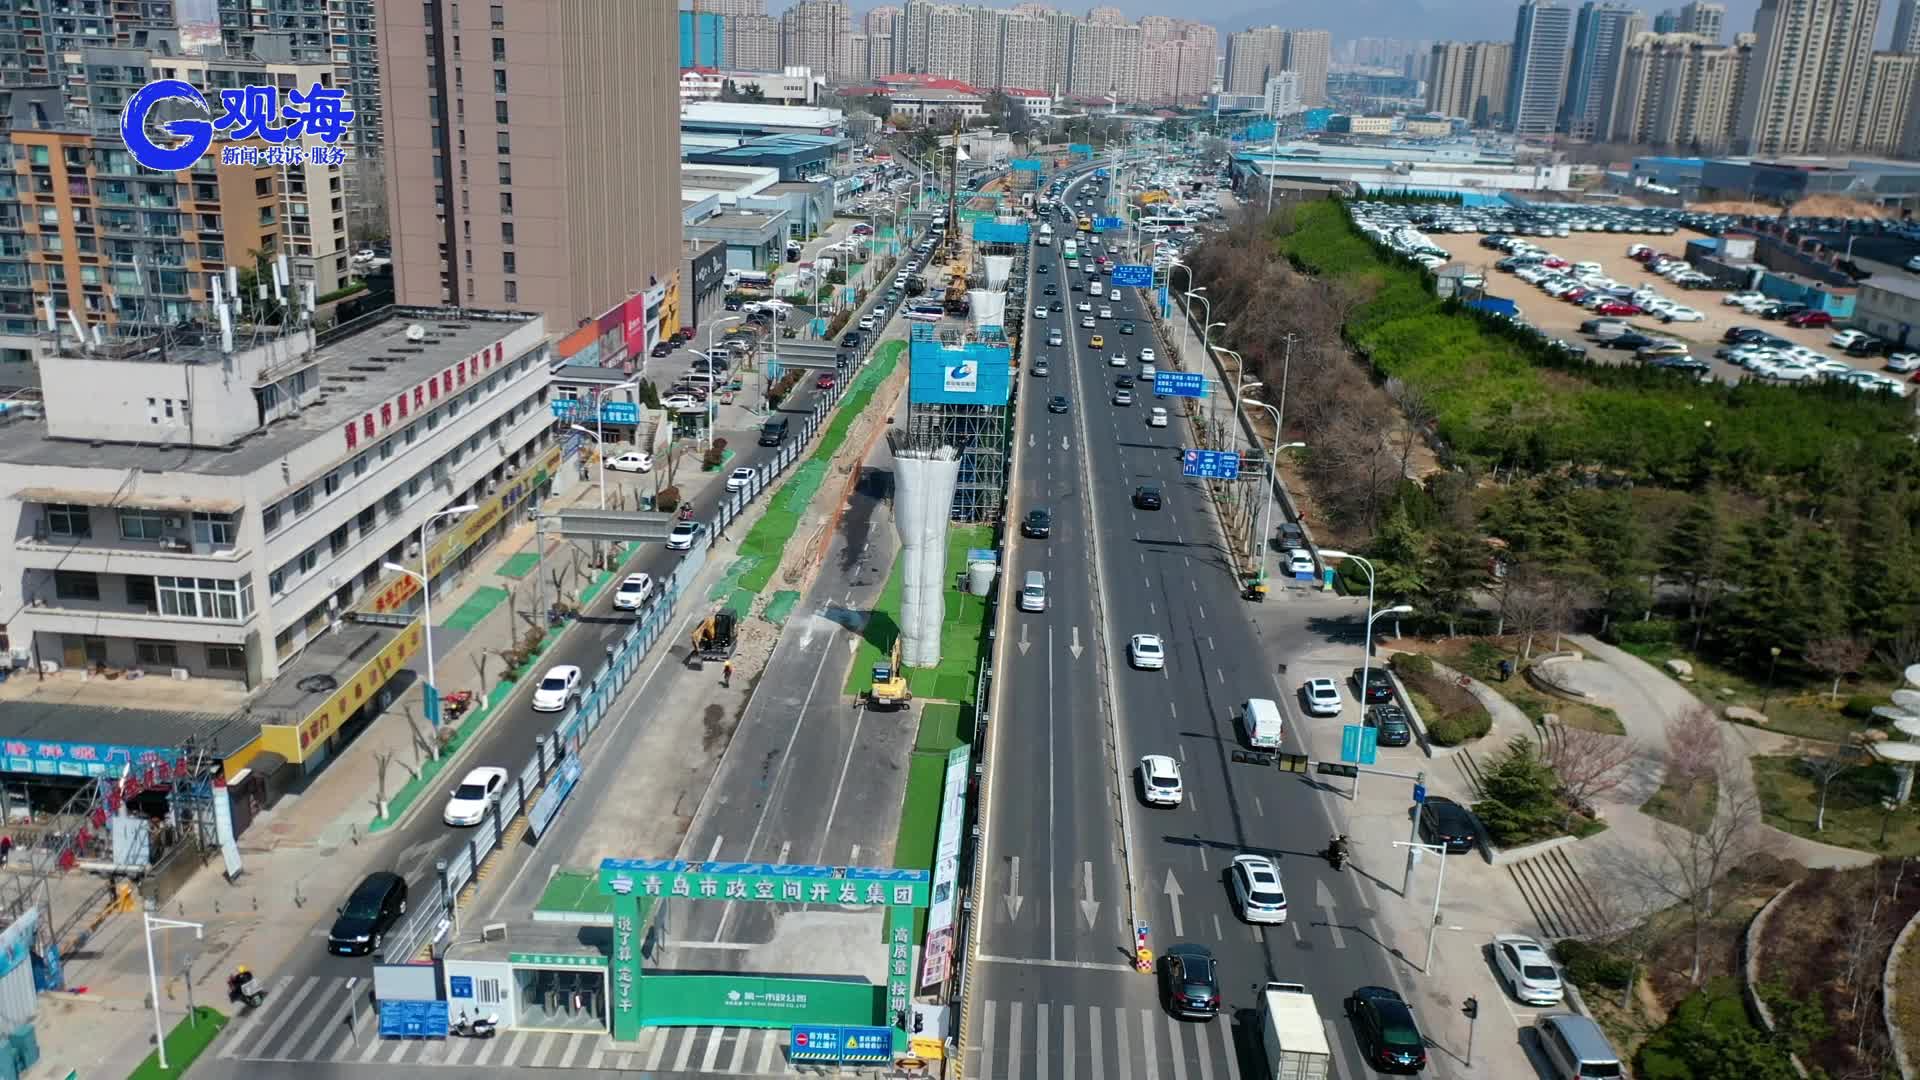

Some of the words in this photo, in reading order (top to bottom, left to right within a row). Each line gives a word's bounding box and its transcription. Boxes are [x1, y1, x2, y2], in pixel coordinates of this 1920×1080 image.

[642, 876, 913, 904] 青岛市政空间开发集团
[893, 927, 909, 976] 高质量
